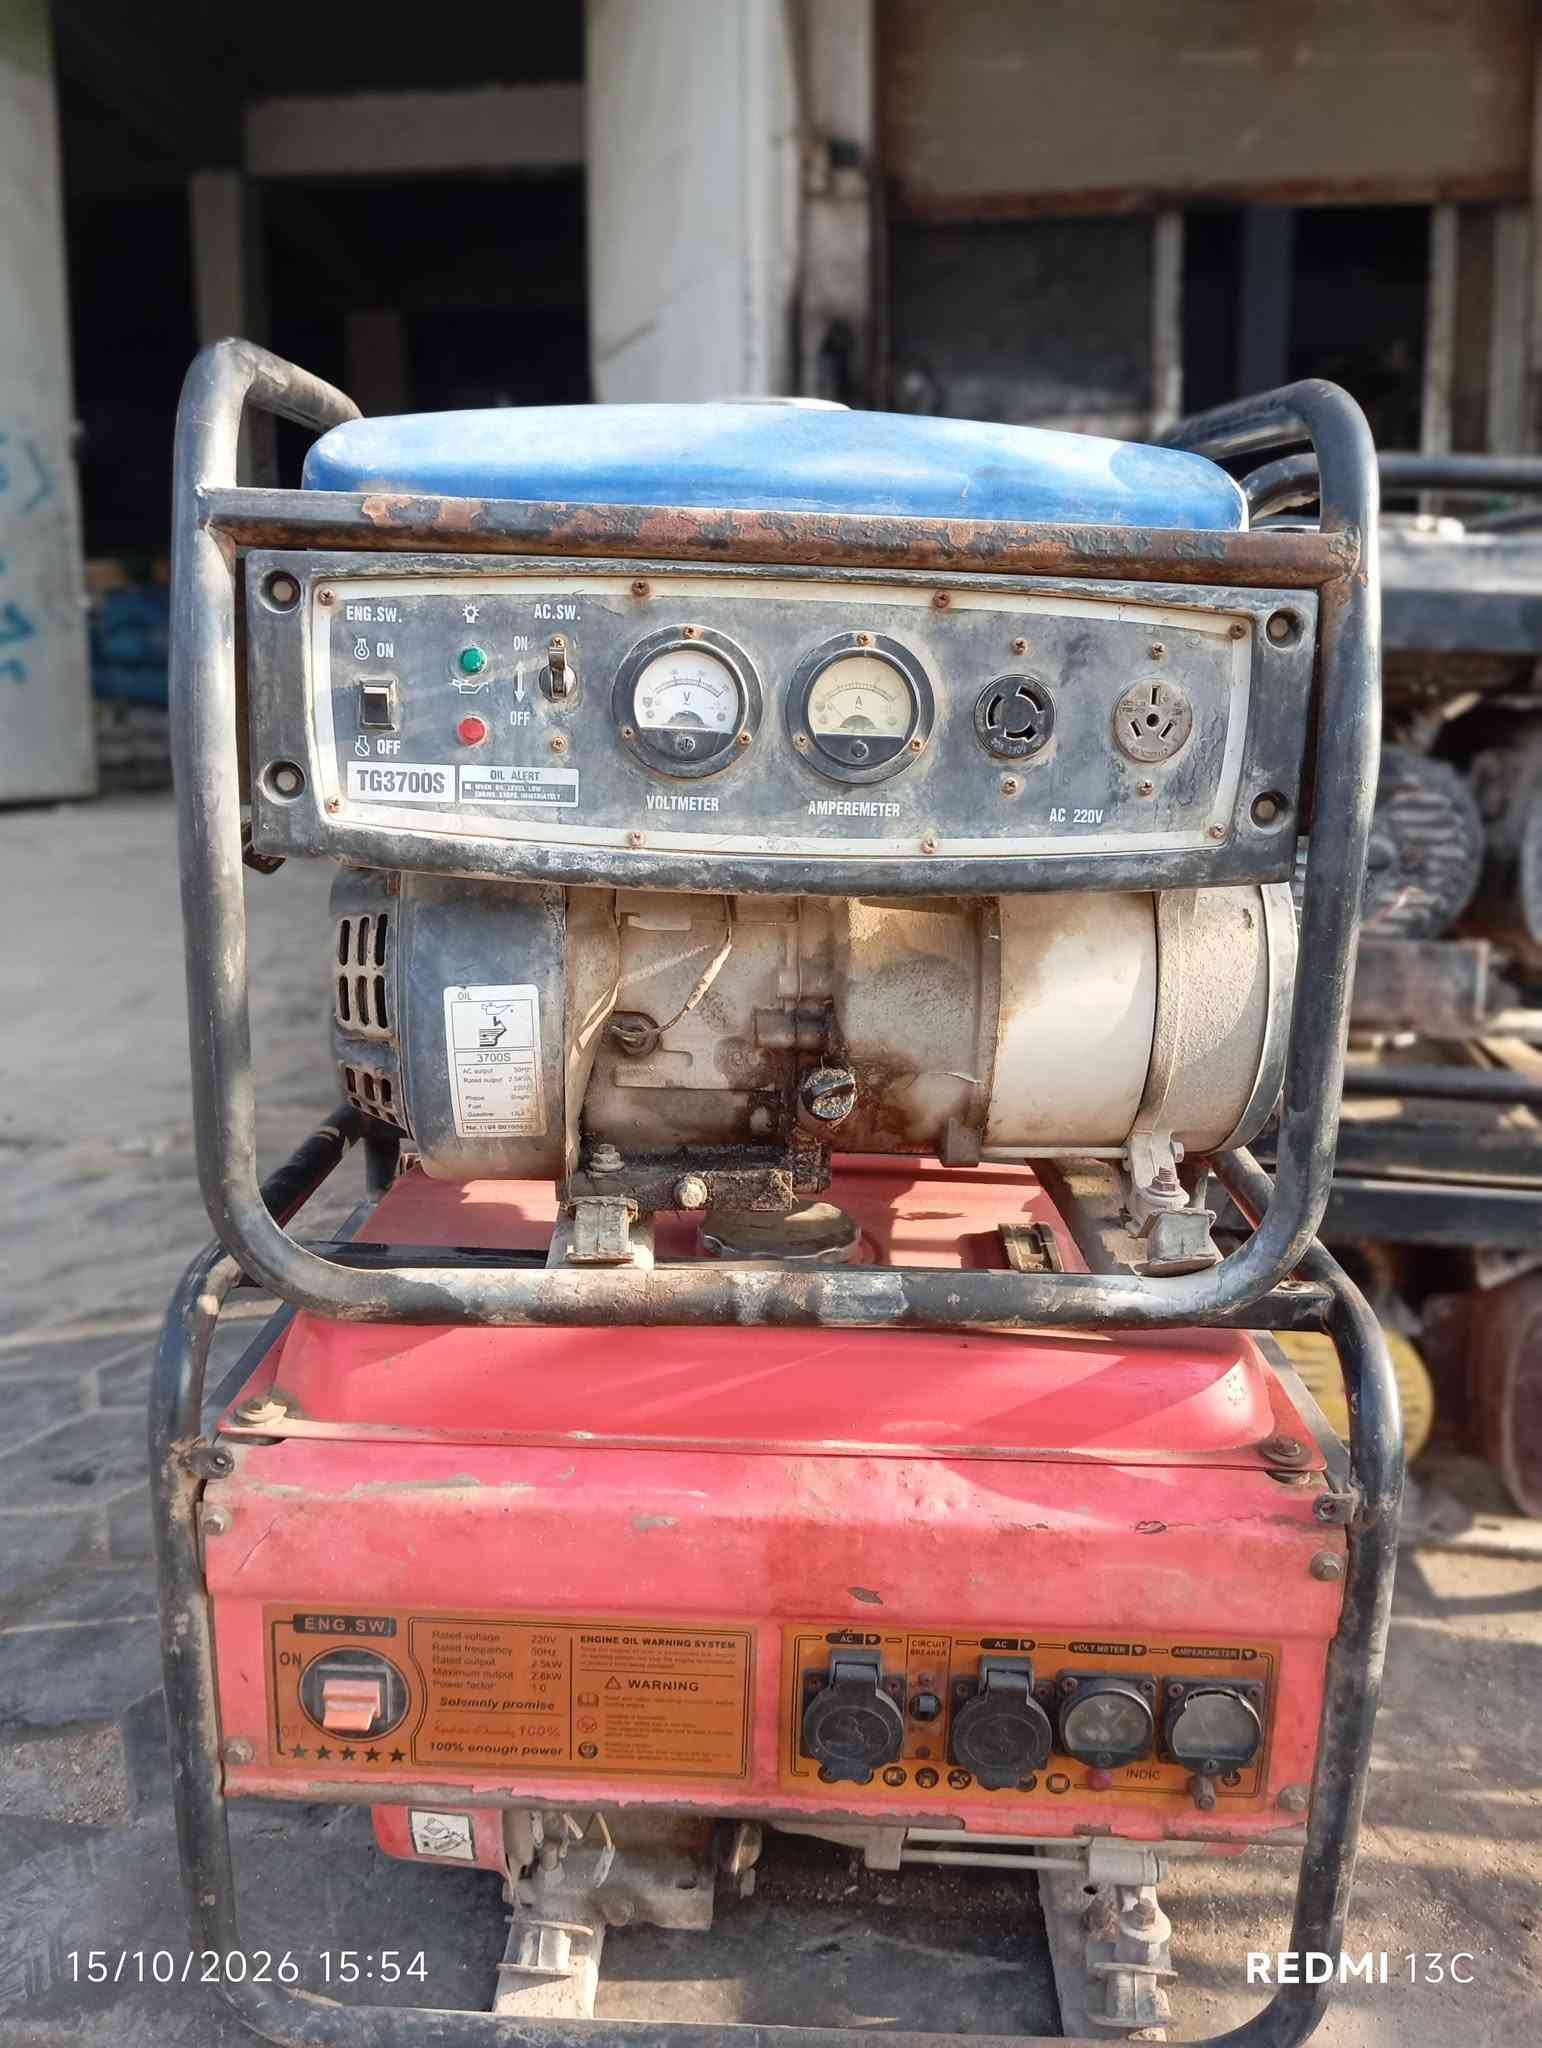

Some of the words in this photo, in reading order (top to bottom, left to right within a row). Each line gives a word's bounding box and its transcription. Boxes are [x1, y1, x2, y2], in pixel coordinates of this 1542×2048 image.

[346, 605, 403, 624] ENG.SW.
[534, 603, 581, 621] AC.SW.
[376, 643, 394, 659] ON
[514, 636, 528, 651] ON
[682, 690, 691, 703] V
[855, 694, 863, 706] A
[510, 710, 530, 726] OFF
[376, 738, 400, 755] OFF
[356, 769, 445, 796] TG3700S
[489, 769, 505, 781] OIL
[511, 770, 541, 782] ALERT
[646, 794, 720, 812] VOLTMETER
[807, 800, 900, 818] AMPEREMETER
[1049, 807, 1066, 823] AC
[1073, 808, 1104, 824] 220V
[457, 991, 472, 1001] OIL
[476, 1052, 512, 1063] 3700S
[531, 1634, 557, 1645] 220V
[580, 1634, 620, 1645] ENGINE
[622, 1636, 639, 1646] OIL
[642, 1637, 692, 1649] WARNING
[694, 1639, 737, 1650] SYSTEM
[911, 1639, 946, 1649] CIRCUIT
[994, 1639, 1007, 1649] AC
[279, 1651, 302, 1666] ON
[627, 1678, 700, 1693] WARNING
[440, 1696, 498, 1709] Solemnly
[502, 1699, 556, 1712] promise
[430, 1741, 465, 1752] 100%
[467, 1743, 518, 1756] enough
[521, 1745, 564, 1758] power
